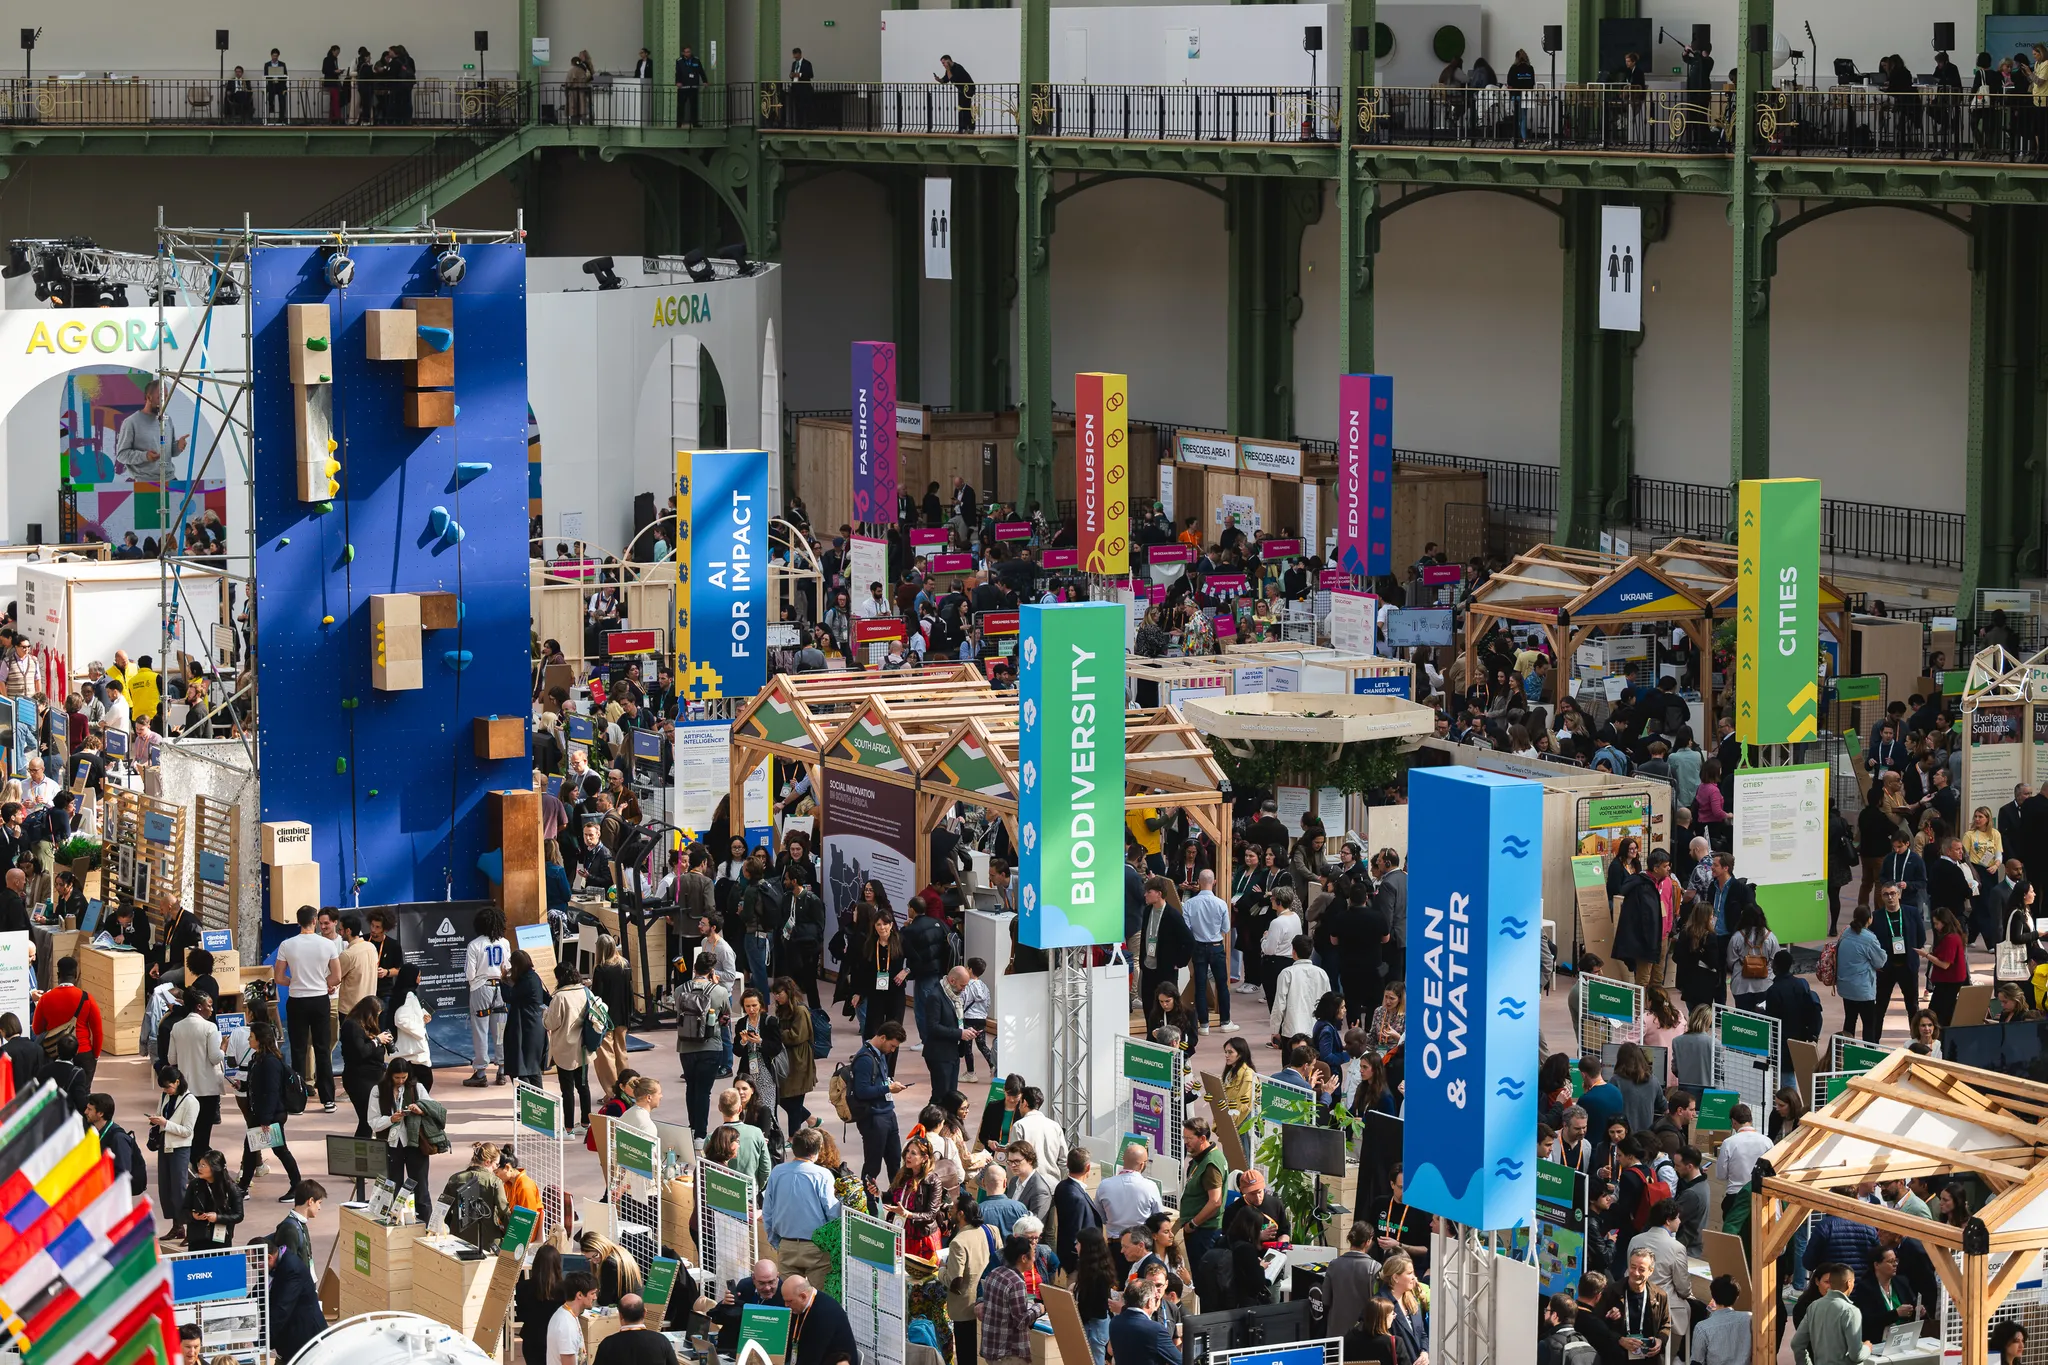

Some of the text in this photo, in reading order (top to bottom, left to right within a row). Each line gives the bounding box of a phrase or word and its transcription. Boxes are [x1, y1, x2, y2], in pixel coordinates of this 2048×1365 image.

[652, 293, 711, 327] AGORA
[26, 318, 178, 354] AGORA
[896, 415, 920, 425] ETING ROOM
[859, 388, 868, 475] FASHION
[1182, 443, 1230, 457] FRESCOES AREA 1
[1244, 450, 1295, 465] FRESCOES AREA 2
[1085, 413, 1095, 532] INCLUSION
[1348, 410, 1359, 538] EDUCATION
[709, 561, 727, 589] AI
[732, 490, 751, 657] FOR IMPACT
[1621, 593, 1653, 602] UKRAINE
[1778, 566, 1797, 656] CITIES
[1240, 723, 1274, 732] Rethinking
[1972, 723, 2010, 734] Solutions
[2035, 723, 2048, 734] by
[683, 737, 725, 745] INTELLIGENCE?
[853, 738, 891, 755] SOUTH AFRICA
[1070, 644, 1096, 905] BIODIVERSITY
[829, 780, 875, 800] SOCIAL INNOVATION
[277, 827, 310, 836] climbing
[278, 834, 307, 843] district
[484, 945, 503, 968] 10
[1423, 906, 1444, 1079] OCEAN
[1599, 993, 1620, 1003] NETCARBON
[1447, 891, 1470, 1109] & WATER
[1731, 1025, 1758, 1037] OPENFORESTS
[1143, 1059, 1164, 1069] ANALYTICS
[1536, 1171, 1563, 1184] PLANET WILD
[721, 1187, 741, 1199] SOLUTIONS
[1552, 1208, 1566, 1218] EARTH
[356, 1237, 368, 1252] GLOBAL
[858, 1233, 885, 1249] PRESERVALAND
[356, 1257, 369, 1270] WATCH
[187, 1271, 213, 1281] SYRINX
